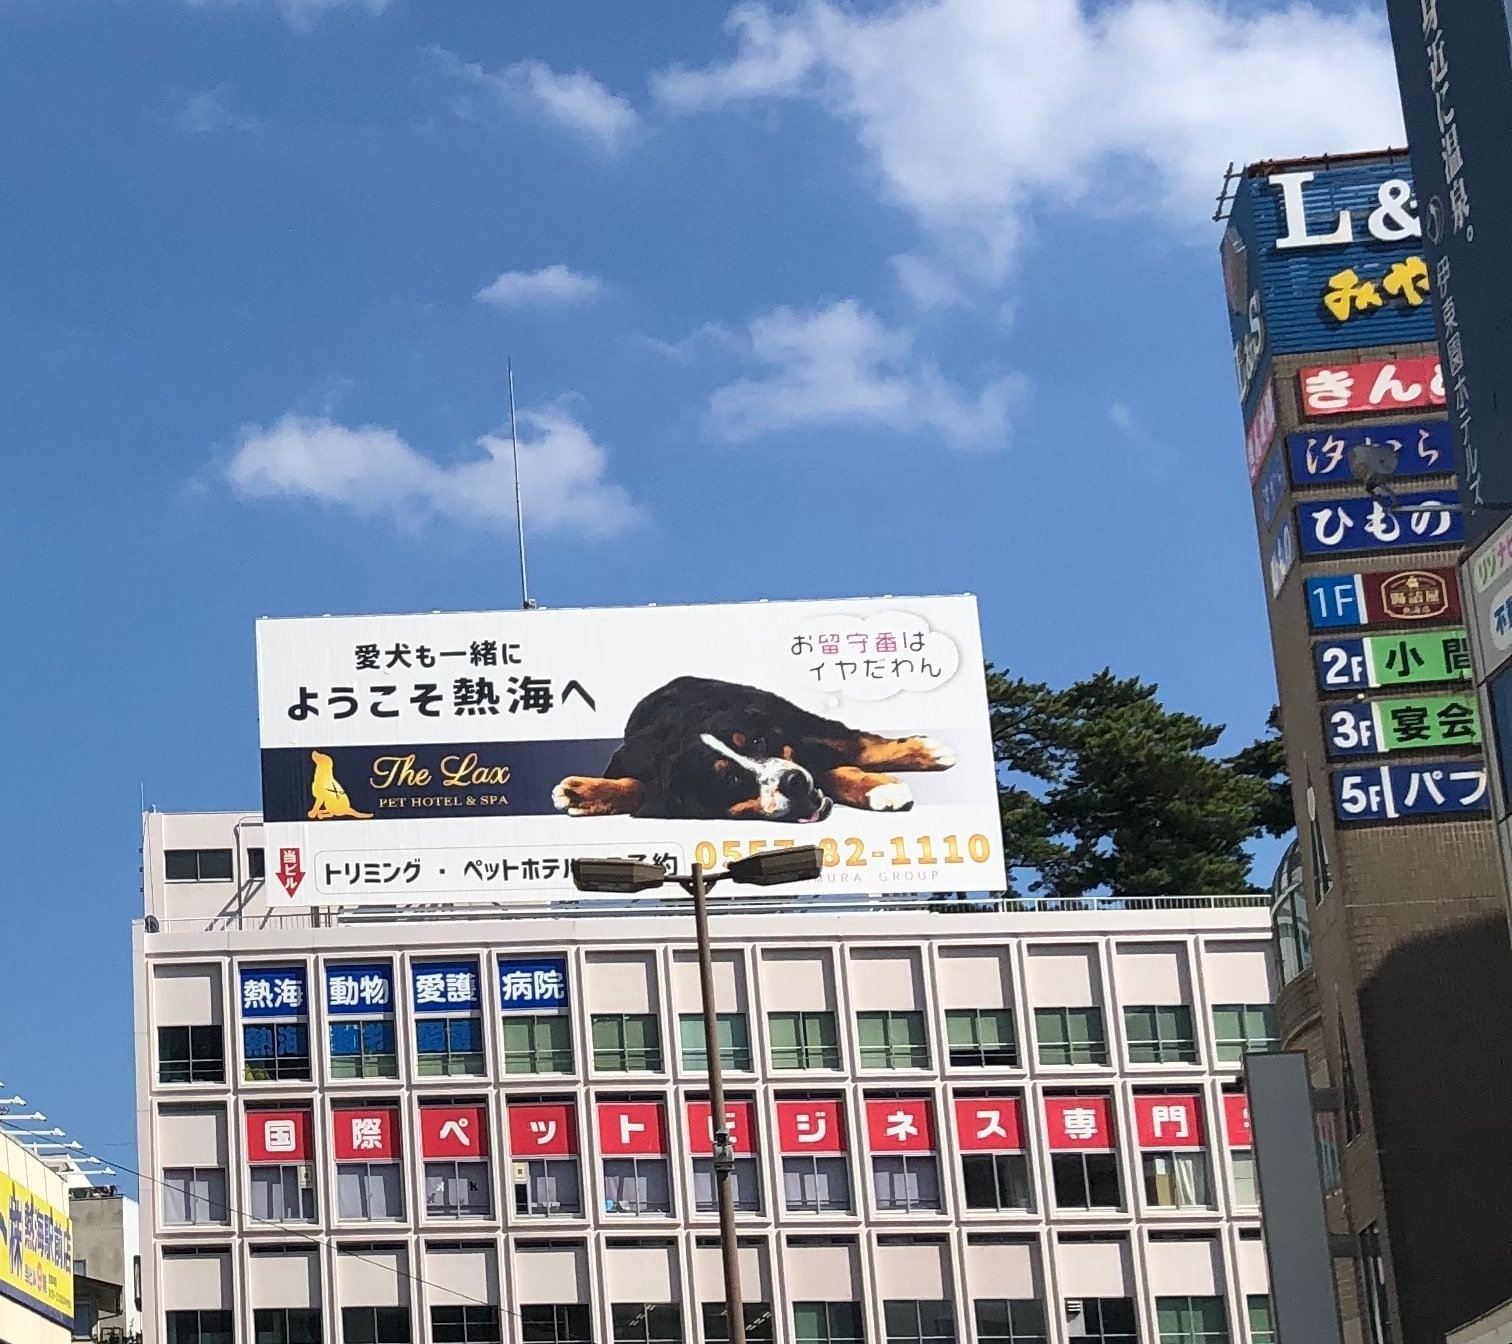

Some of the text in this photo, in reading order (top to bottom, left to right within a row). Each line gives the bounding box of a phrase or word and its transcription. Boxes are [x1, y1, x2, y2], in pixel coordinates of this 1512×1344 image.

[1313, 585, 1353, 618] 1F
[354, 640, 522, 670] 愛犬も一緒に
[791, 631, 926, 656] お留守番は
[809, 657, 942, 680] イヤだわん
[1323, 647, 1364, 685] 2F
[287, 676, 596, 722] ようこそ熱海へ
[1330, 710, 1371, 748] 3F
[370, 752, 511, 790] The Lax
[378, 795, 509, 808] PET HOTEL & SPA
[1341, 776, 1381, 814] 5F
[283, 849, 297, 890] 当ビル
[878, 870, 940, 883] GROUP
